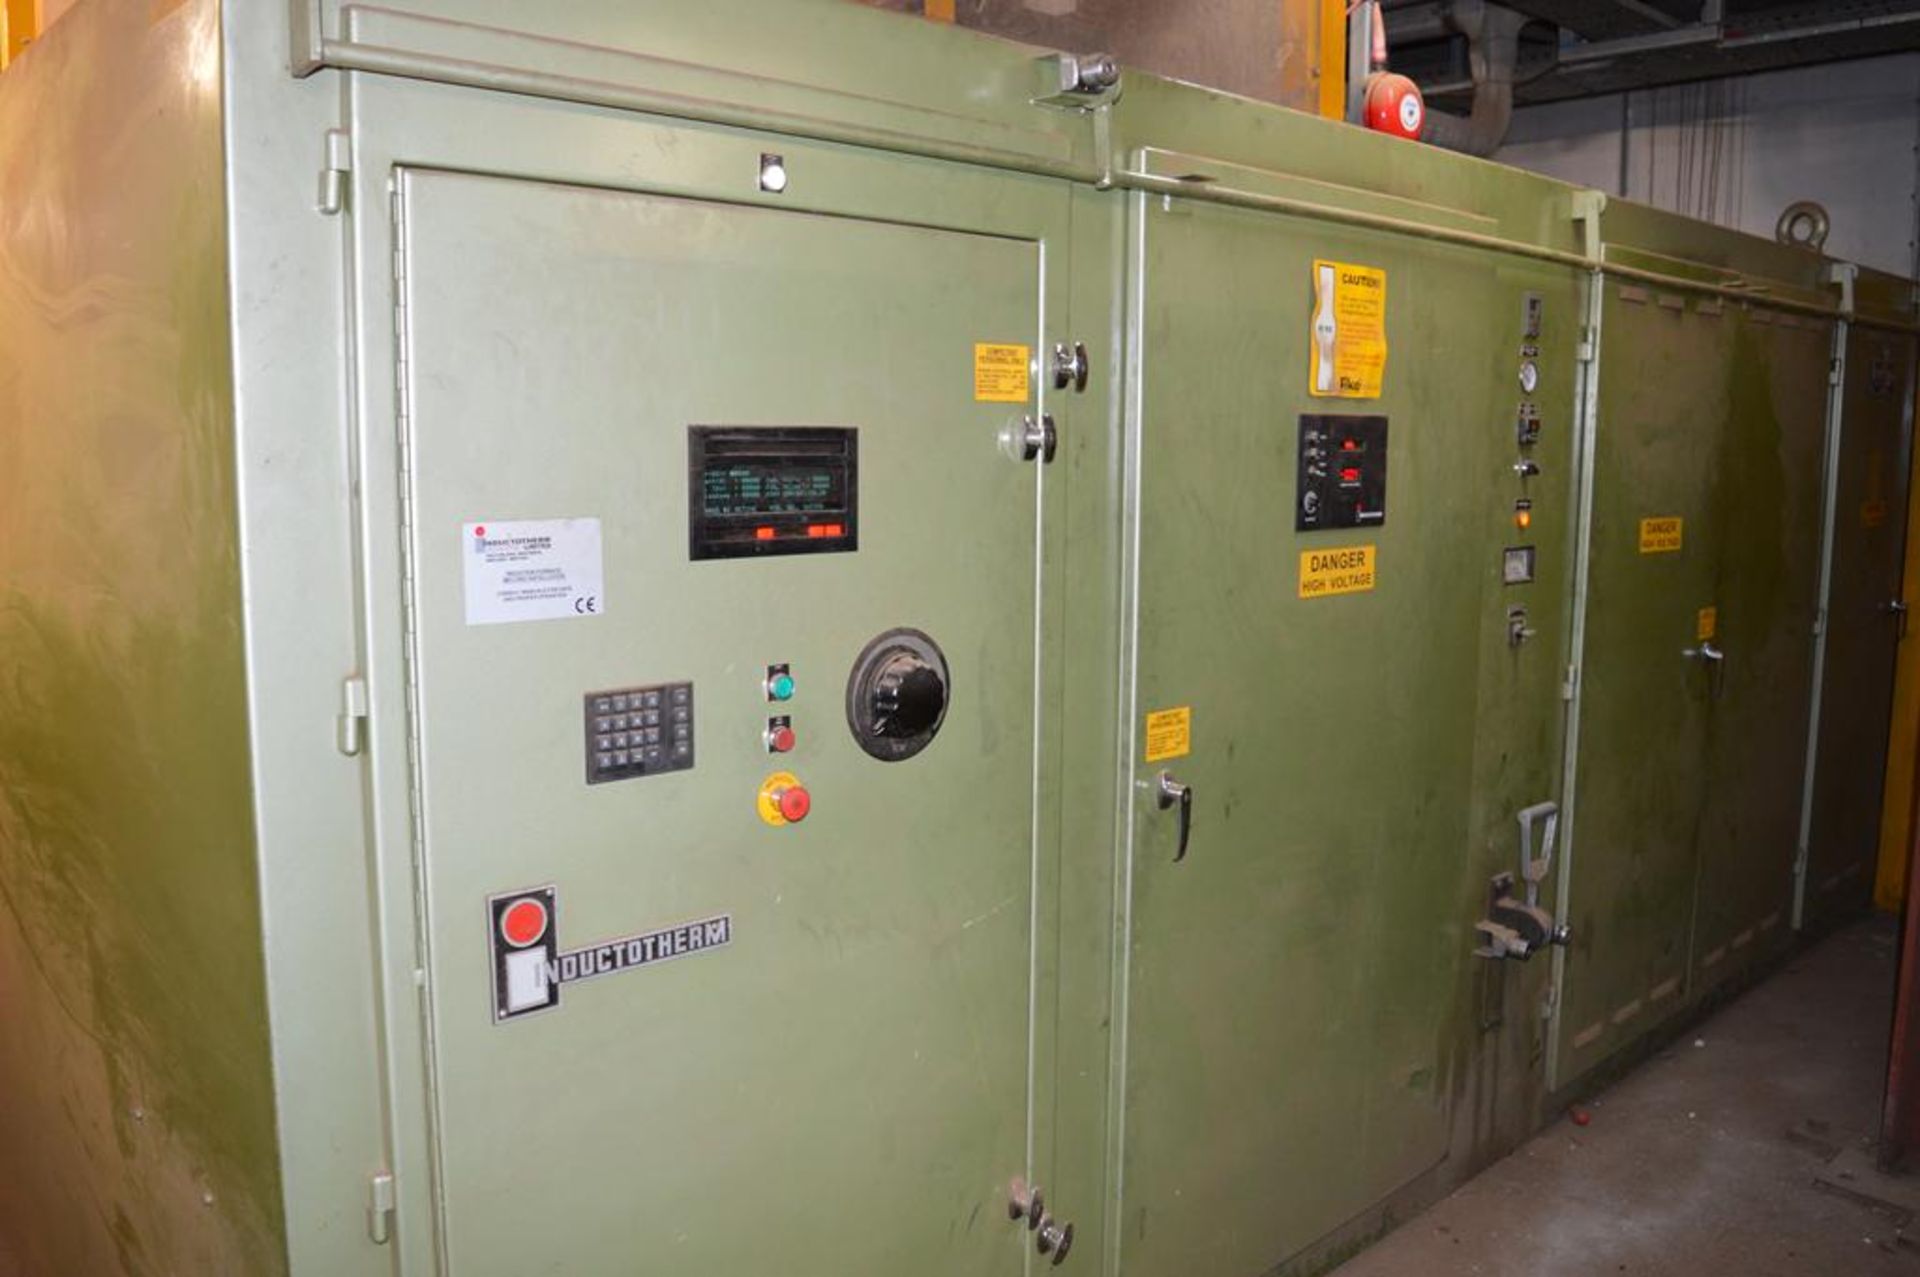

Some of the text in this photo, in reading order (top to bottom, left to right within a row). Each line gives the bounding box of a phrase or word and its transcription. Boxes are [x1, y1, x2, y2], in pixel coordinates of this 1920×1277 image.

[1310, 551, 1366, 572] DANGER
[1303, 573, 1372, 592] HIGH VOLTAGE
